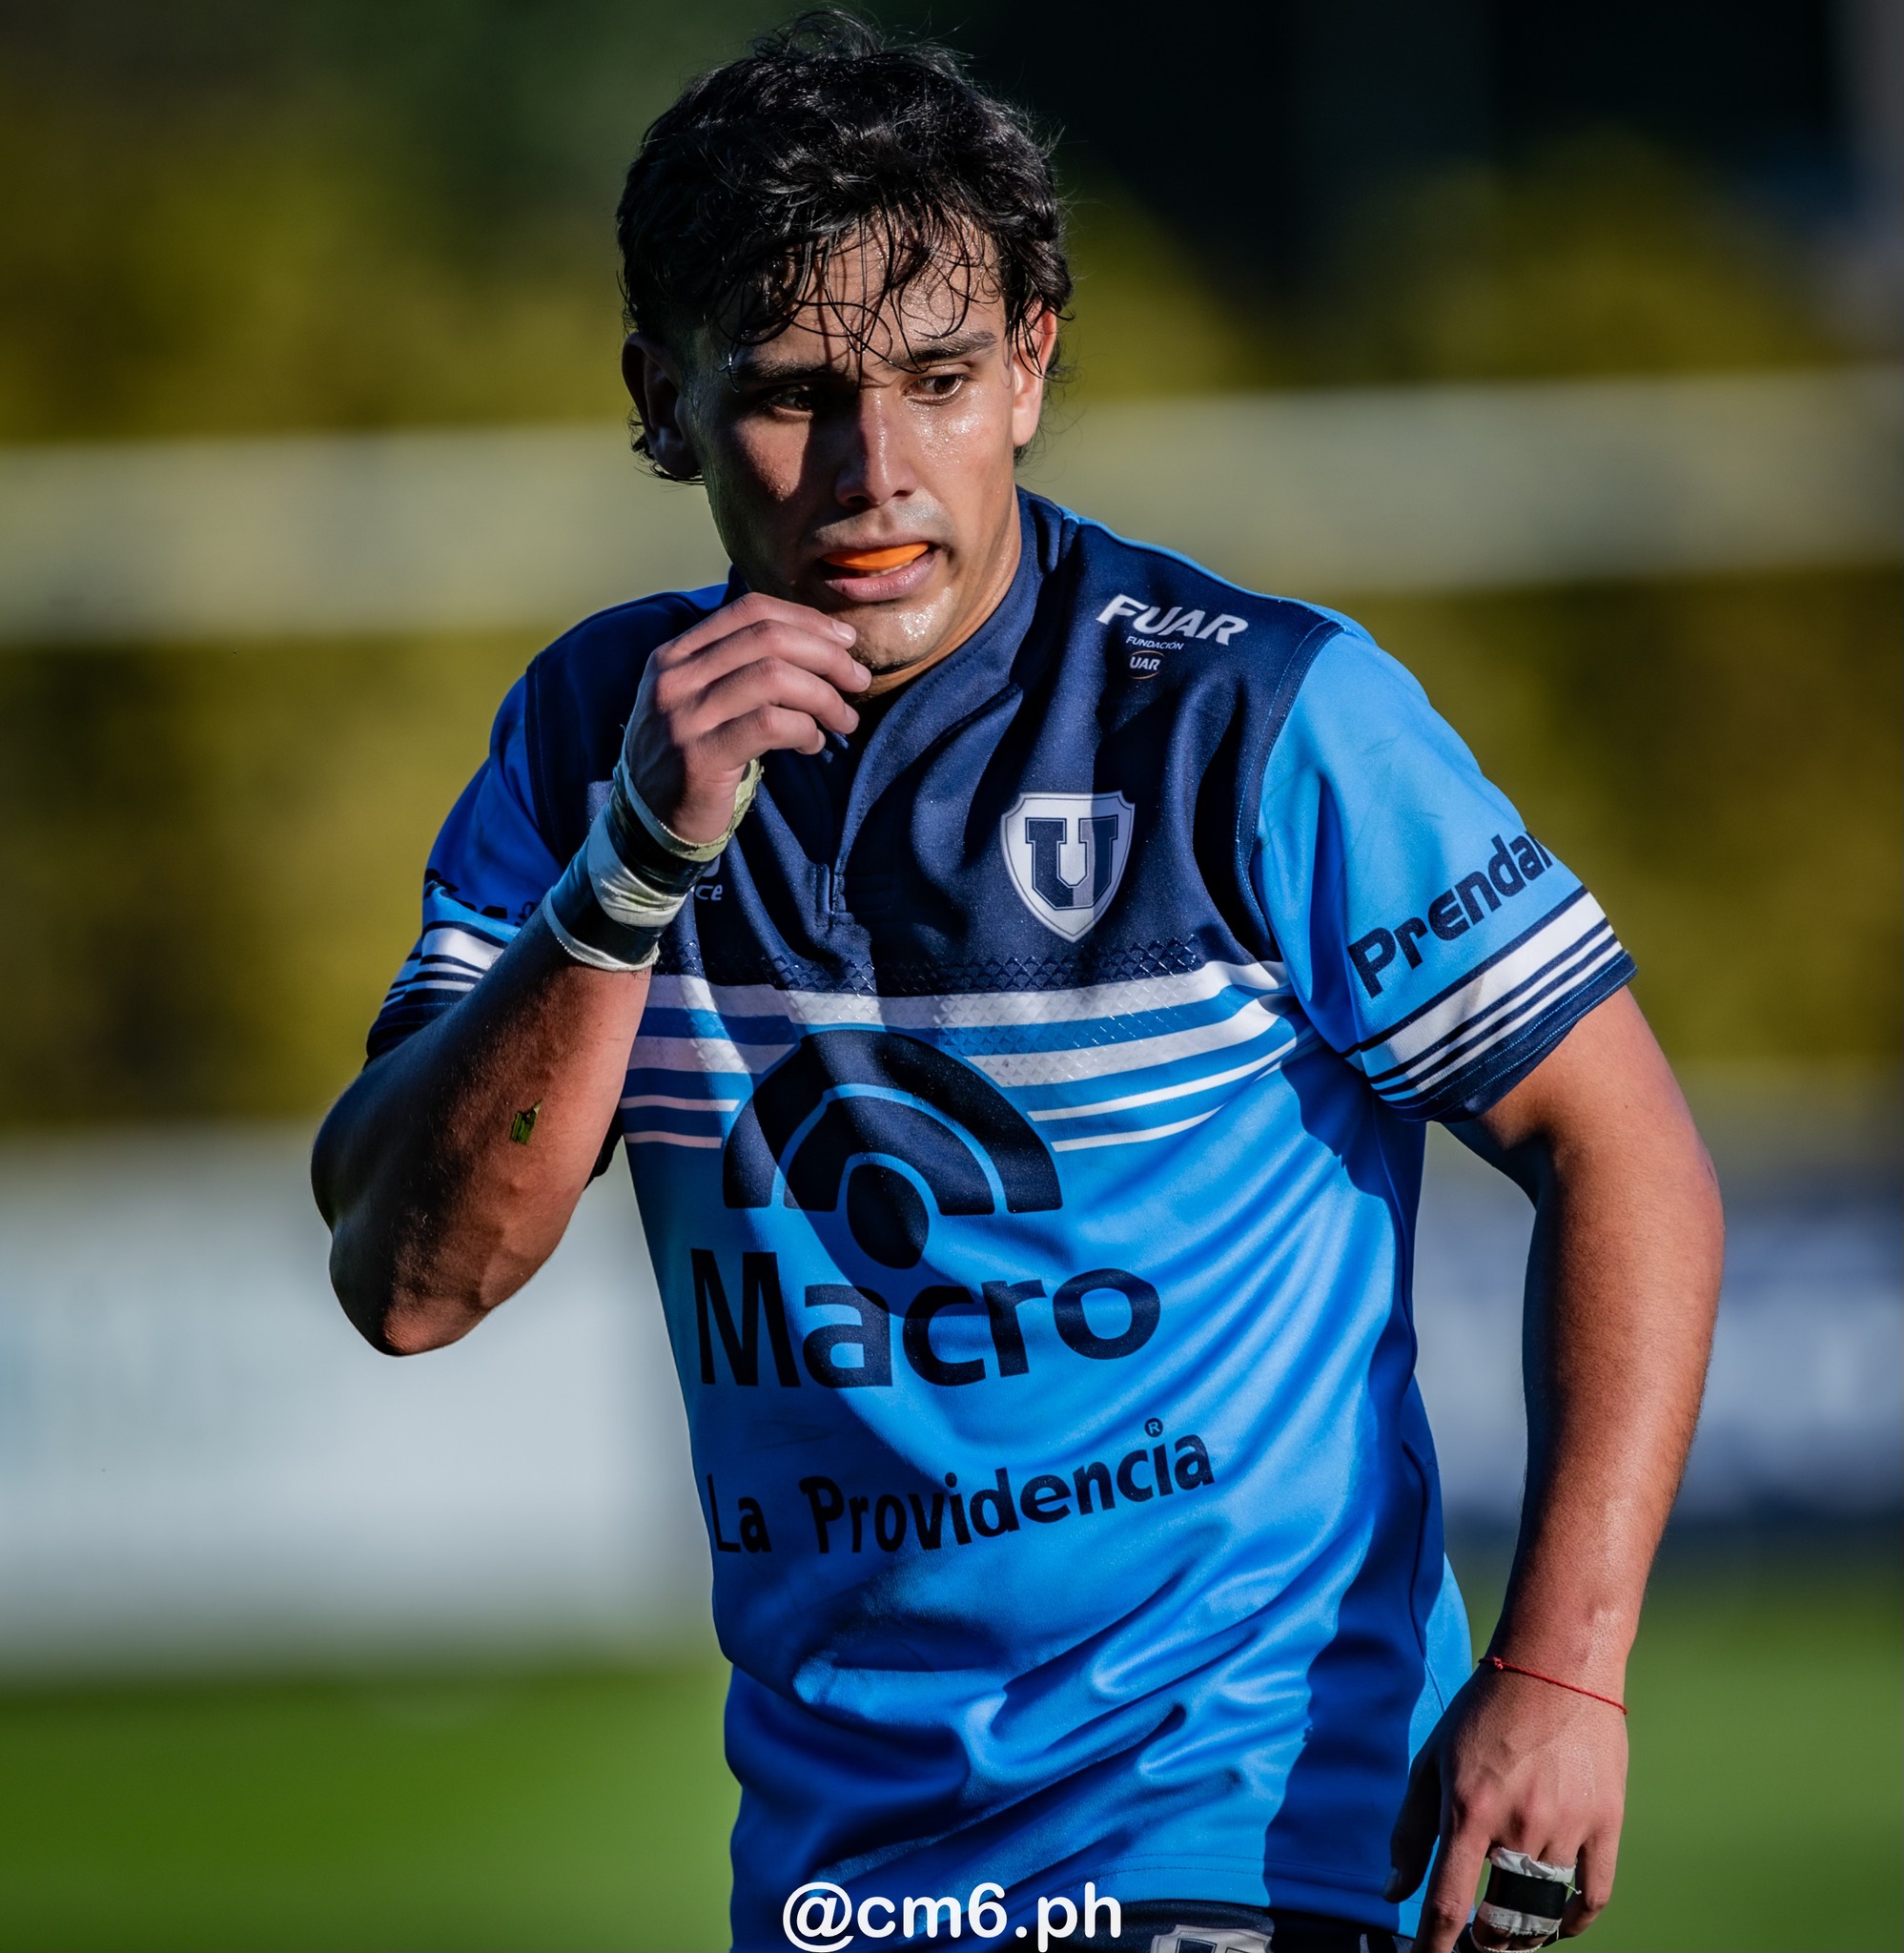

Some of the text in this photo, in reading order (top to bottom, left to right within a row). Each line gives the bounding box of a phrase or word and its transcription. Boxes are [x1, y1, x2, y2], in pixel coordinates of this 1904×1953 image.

[1096, 593, 1249, 646] FUAR
[1130, 656, 1161, 671] UAR
[1025, 814, 1119, 911] U
[690, 1247, 1161, 1388] Macro
[707, 1473, 772, 1554] La
[799, 1433, 1216, 1554] Providencia
